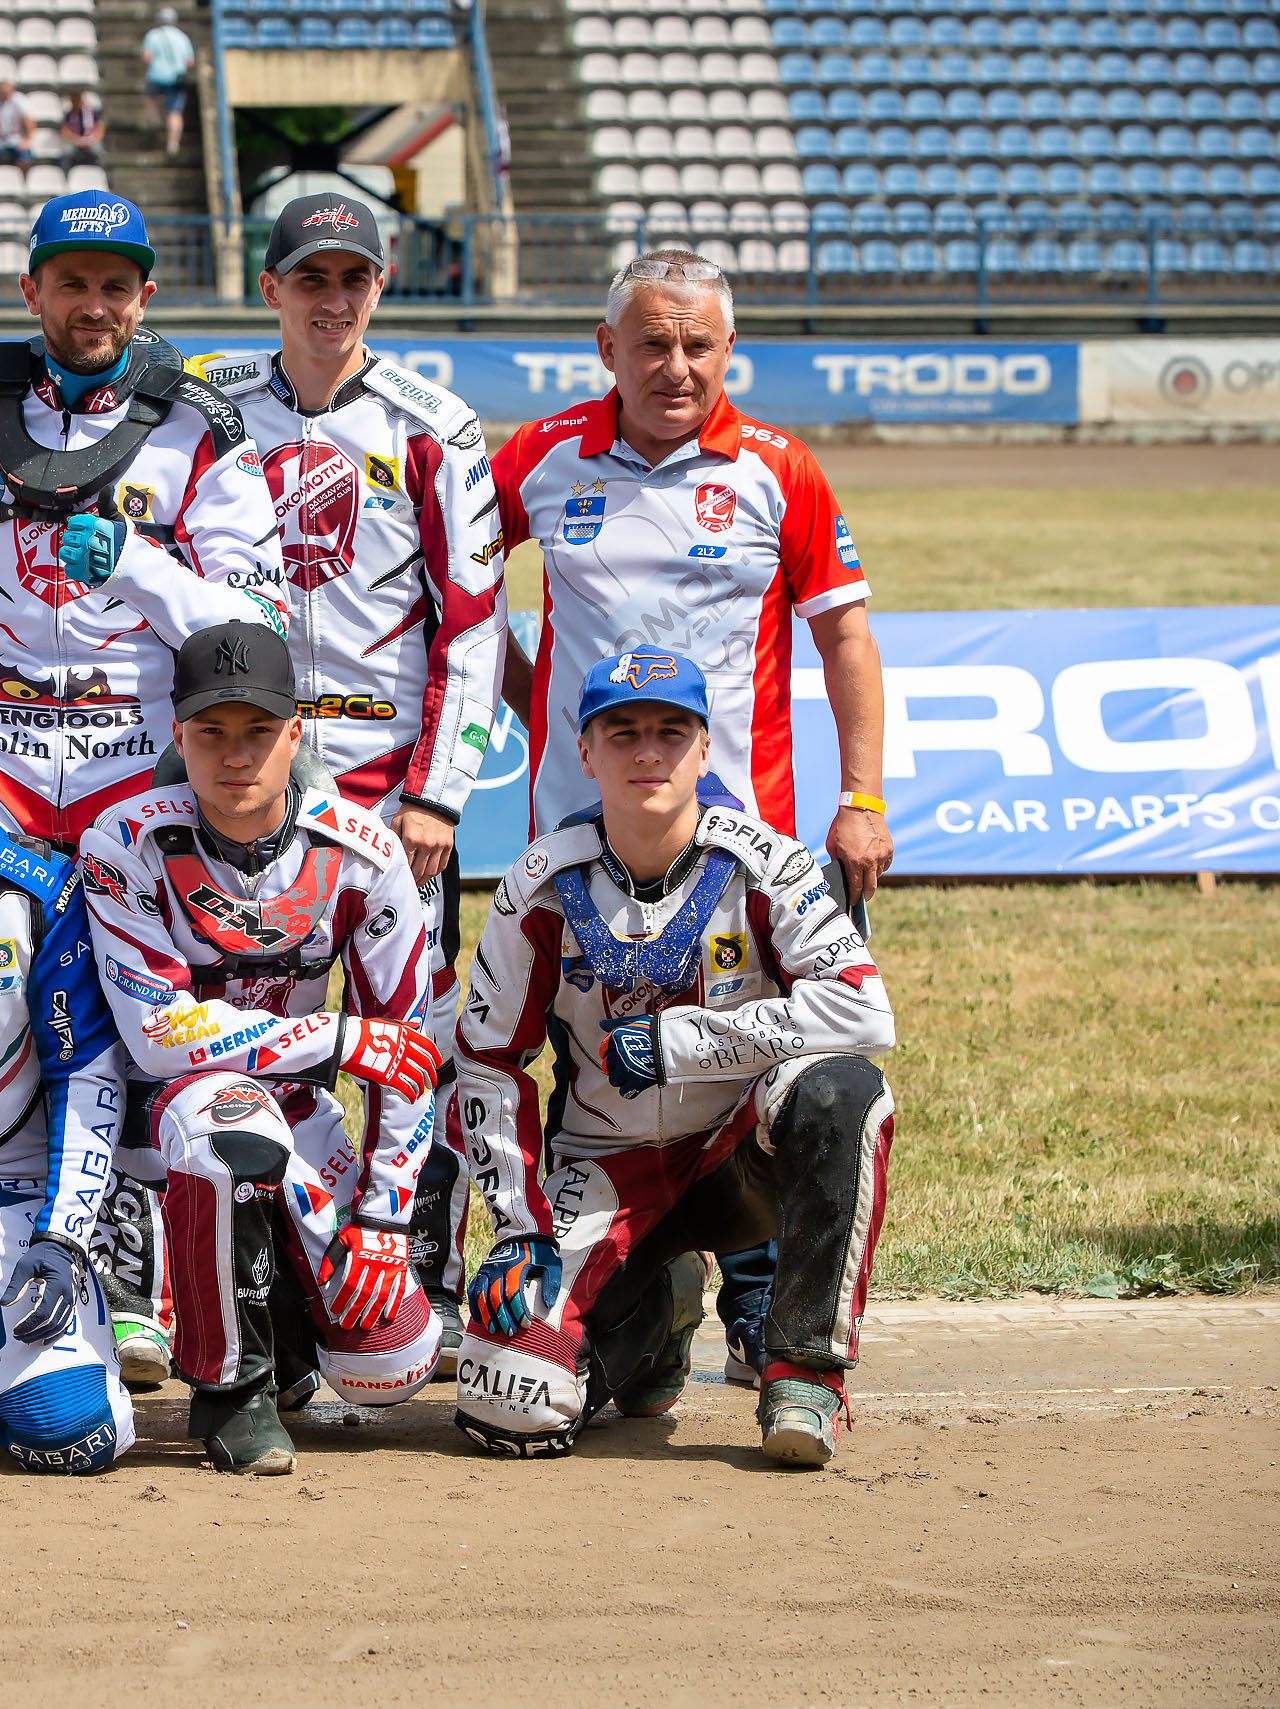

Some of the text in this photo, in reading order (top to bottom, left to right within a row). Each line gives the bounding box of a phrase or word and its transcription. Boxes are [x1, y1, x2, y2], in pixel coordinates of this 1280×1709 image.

[60, 206, 118, 223] MERIDIAN
[69, 220, 105, 234] LIFTS
[813, 353, 1050, 395] TRODO
[182, 391, 219, 415] LIFTS
[274, 458, 345, 521] OKOMOTIV
[65, 730, 158, 760] North
[141, 800, 195, 819] SELS
[935, 800, 1051, 835] CAR
[1061, 793, 1237, 833] PARTS
[345, 817, 393, 858] SELS
[118, 974, 151, 999] GRAND
[162, 1022, 221, 1049] KEBAB
[168, 1003, 209, 1031] WOW
[278, 1012, 331, 1050] SELS
[688, 1001, 794, 1041] YOGGI
[211, 1017, 281, 1058] BERNER
[387, 1028, 410, 1083] SCOTT
[695, 1021, 798, 1053] GASTROBARS
[713, 1036, 791, 1070] BEAR
[406, 1094, 435, 1156] BERNE
[65, 1075, 120, 1239] SAGARI
[8, 1424, 117, 1464] SAGARI
